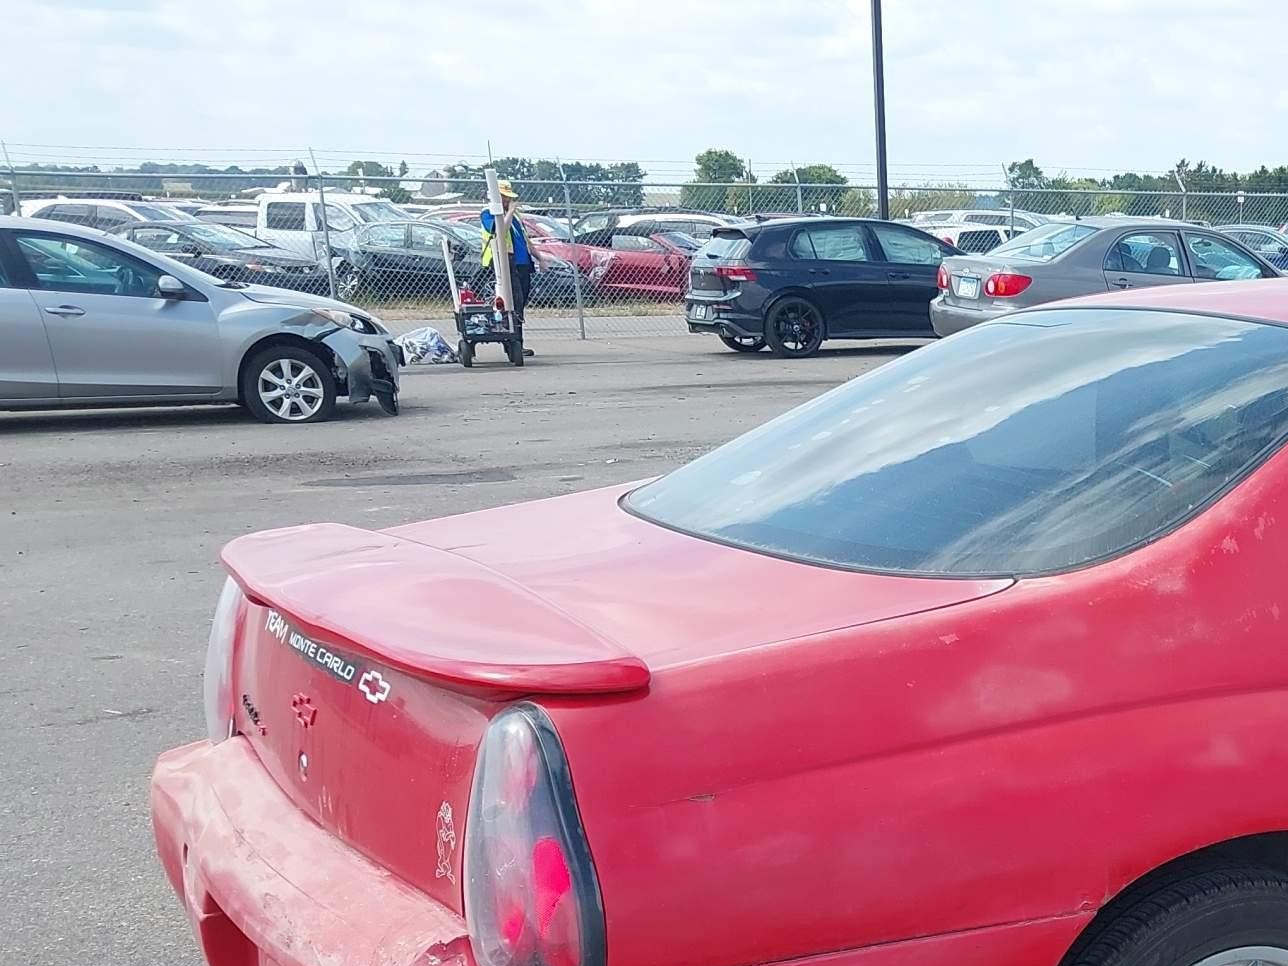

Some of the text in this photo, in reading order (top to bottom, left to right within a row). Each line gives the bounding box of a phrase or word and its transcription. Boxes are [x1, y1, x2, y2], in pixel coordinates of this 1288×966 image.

[265, 609, 356, 681] TEAM MONTE CARLO
